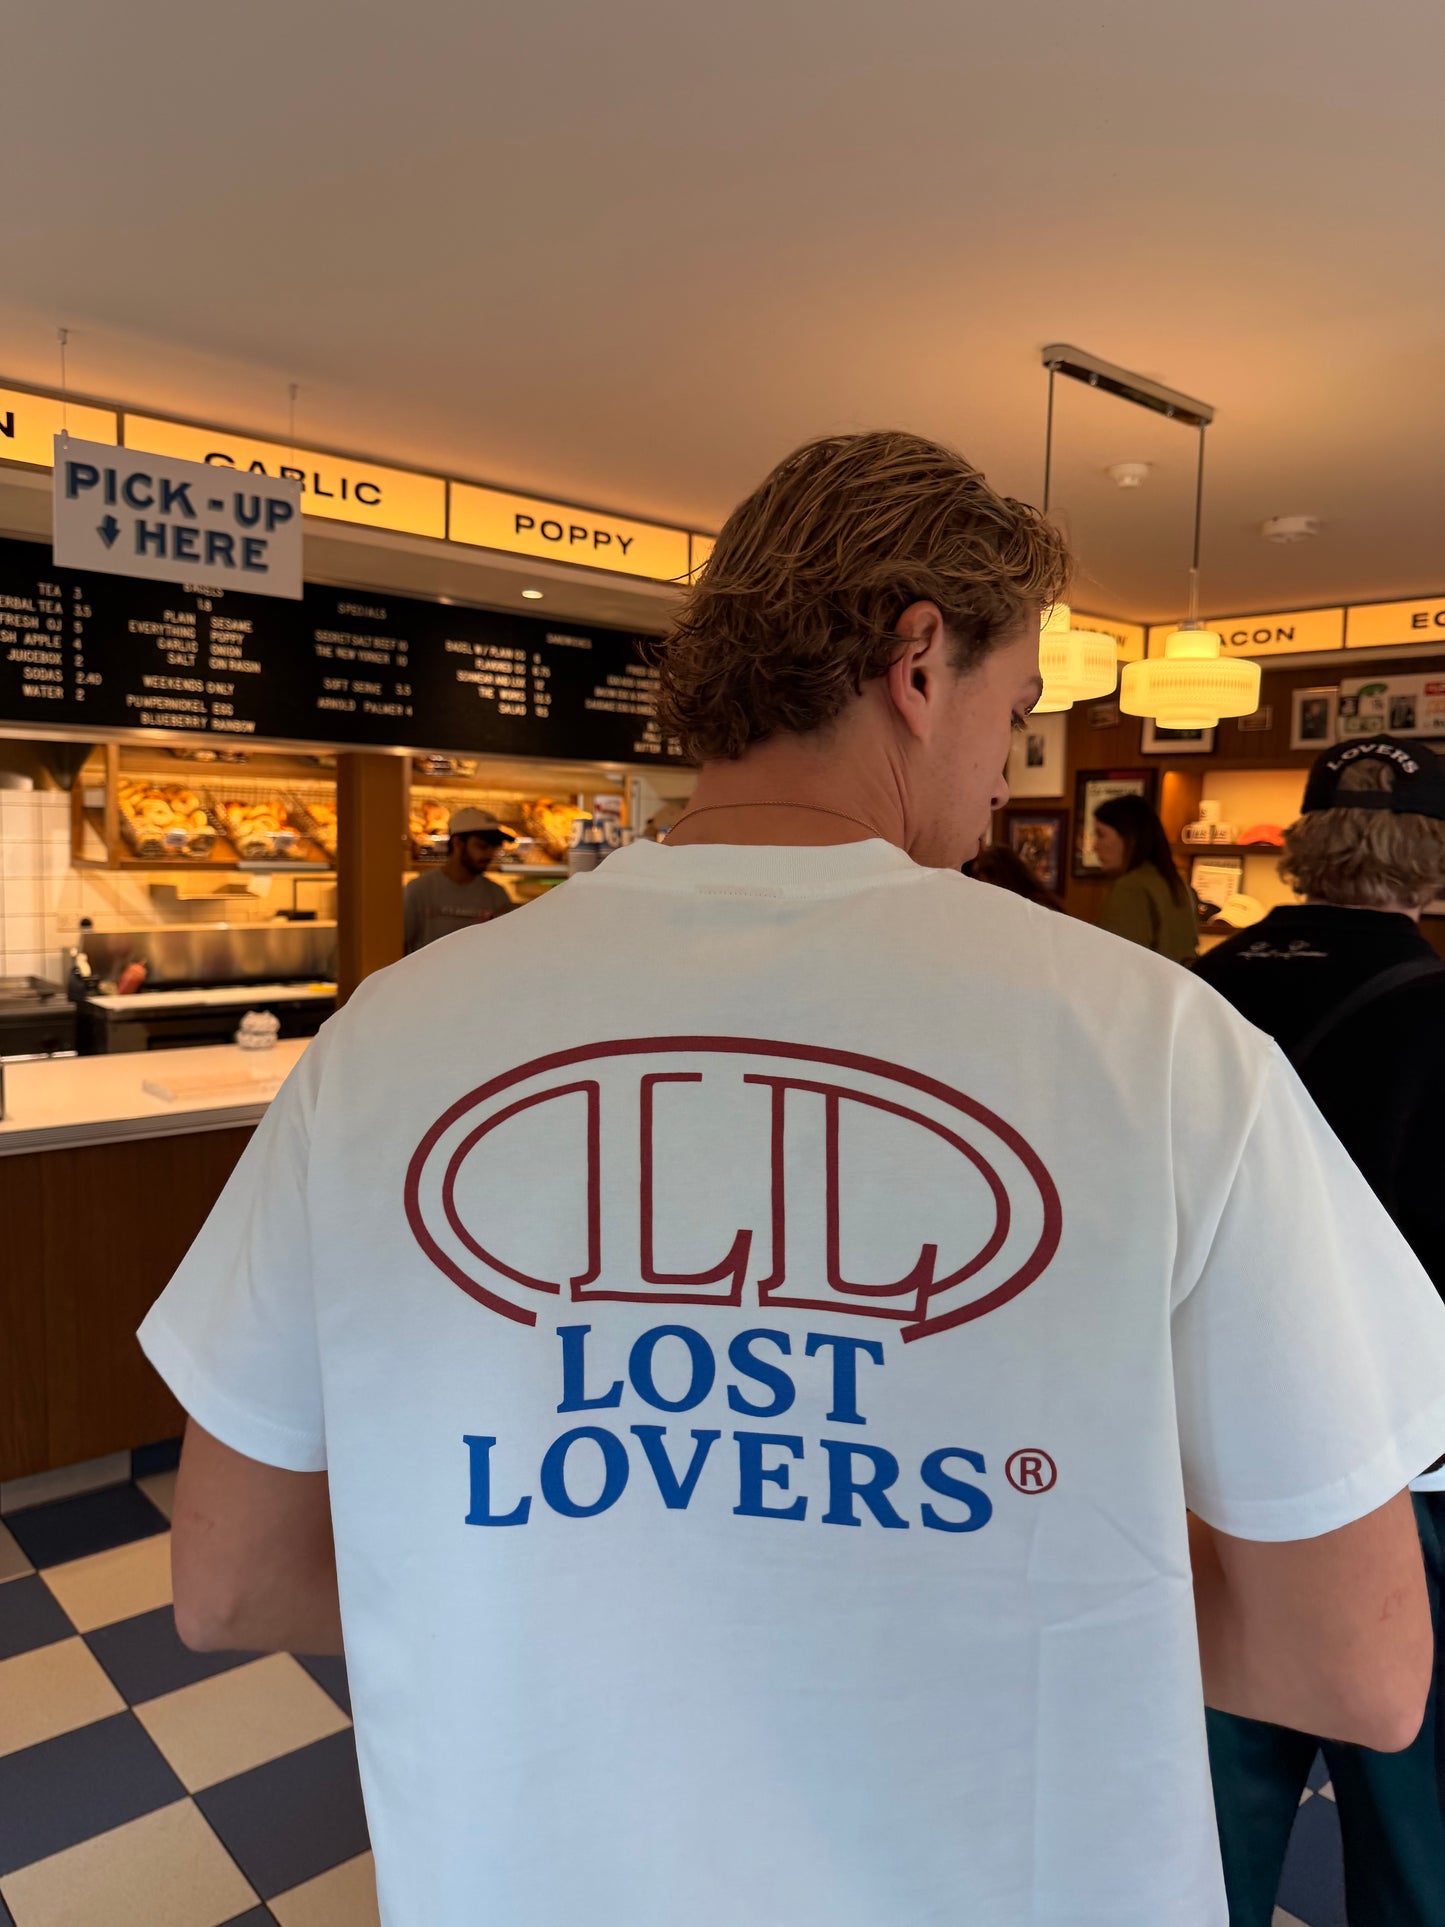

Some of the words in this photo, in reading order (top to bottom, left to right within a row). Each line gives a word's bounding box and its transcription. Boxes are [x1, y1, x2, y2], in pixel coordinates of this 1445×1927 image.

[515, 513, 634, 556] POPPY
[134, 519, 270, 573] HERE
[37, 582, 62, 598] TEA
[37, 599, 63, 615] TEA
[45, 617, 62, 632] OJ
[163, 609, 196, 625] PLAIN
[23, 632, 62, 649] APPLE
[6, 648, 62, 665] JUICEBOX
[73, 653, 84, 667] 2
[166, 651, 195, 666] SALT
[23, 666, 63, 682] SODAS
[22, 683, 64, 699] WATER
[75, 687, 85, 701] 2
[205, 681, 234, 696] ONLY
[140, 711, 207, 729] BLUEBERRY
[1326, 743, 1420, 774] LOVERS
[556, 1324, 884, 1425] LOST
